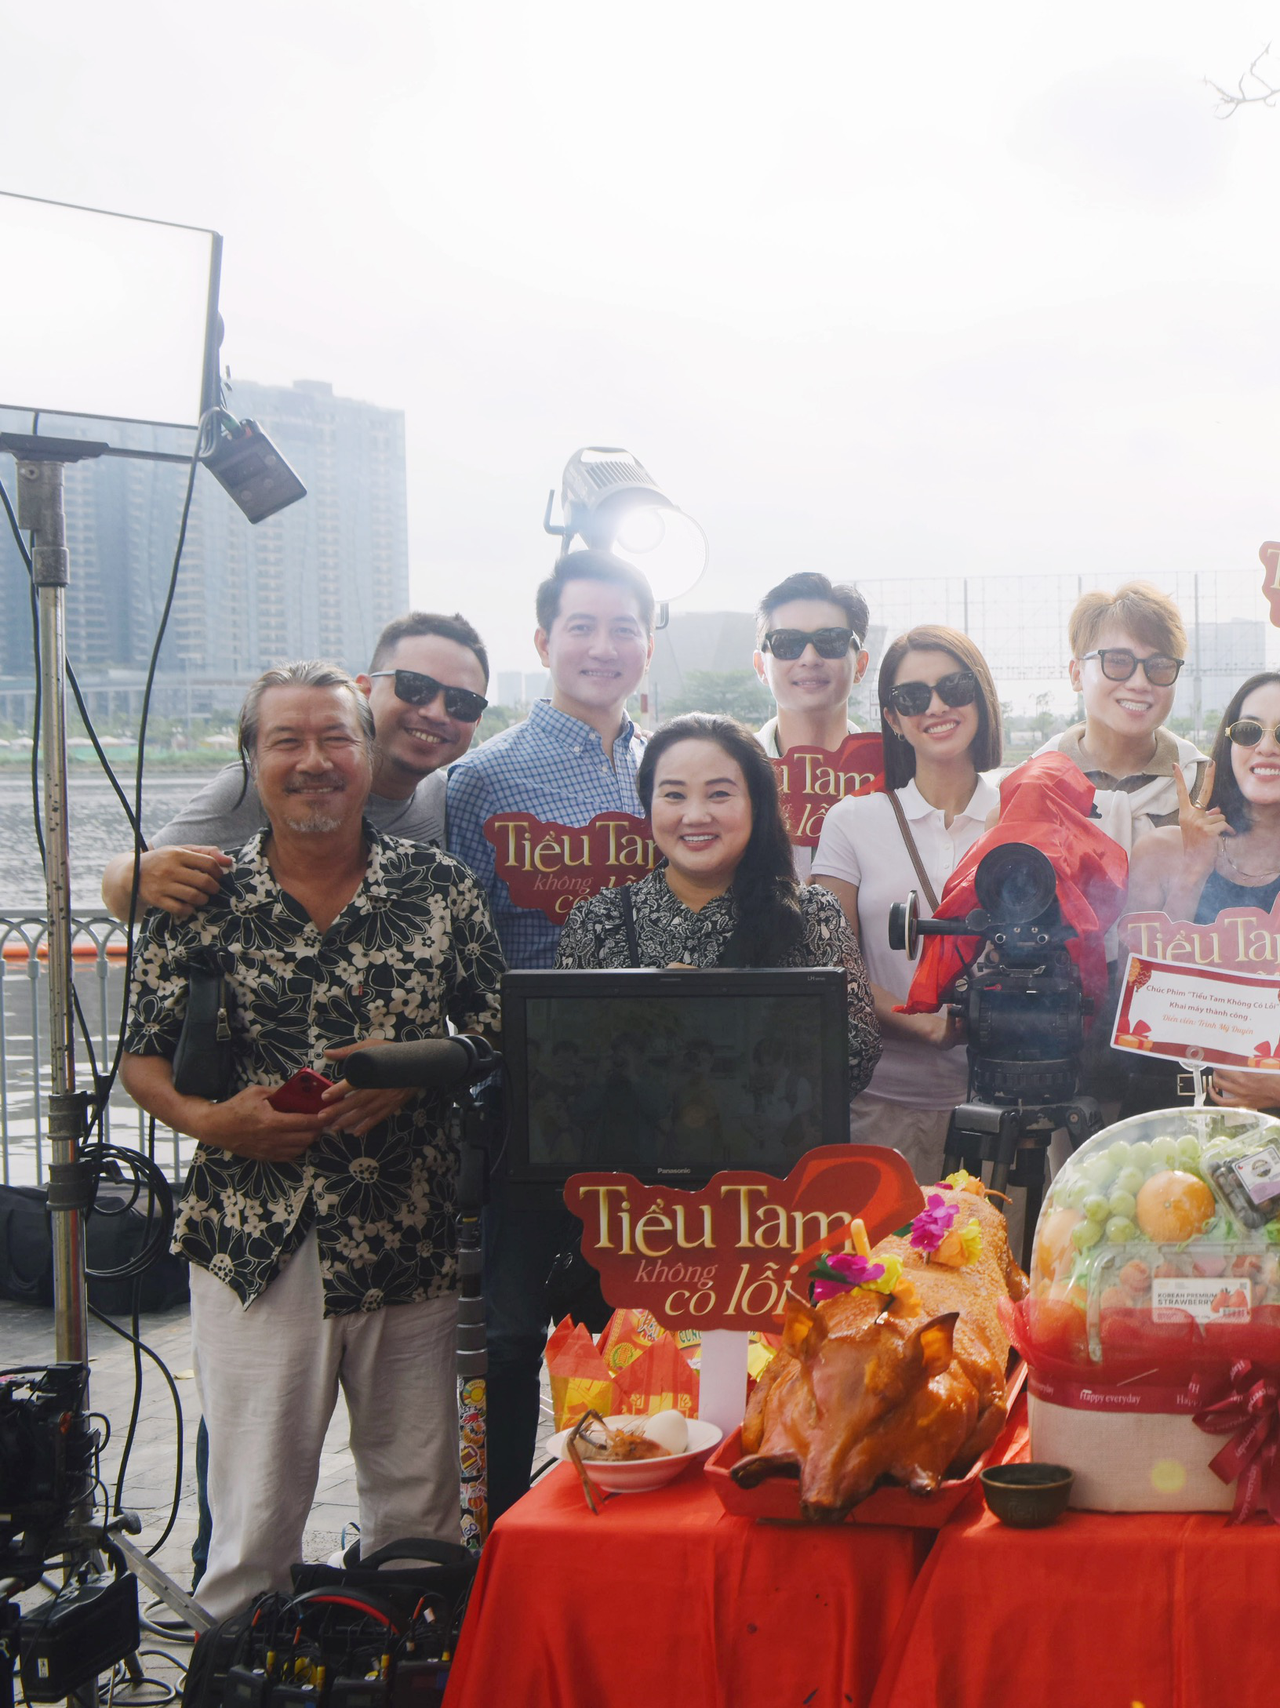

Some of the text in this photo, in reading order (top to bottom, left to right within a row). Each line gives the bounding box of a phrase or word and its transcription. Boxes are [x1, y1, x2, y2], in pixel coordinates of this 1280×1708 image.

[795, 803, 830, 838] lỗ
[495, 822, 592, 872] Tiểu
[534, 874, 593, 894] không
[1146, 984, 1165, 995] Chúc
[1166, 988, 1186, 997] Phim
[1209, 994, 1225, 1004] Tam
[1169, 1001, 1186, 1010] Khai
[580, 1185, 860, 1257] Tiểu Tam
[634, 1259, 718, 1289] không
[723, 1262, 799, 1316] lỗi
[1106, 1394, 1141, 1405] everyday
